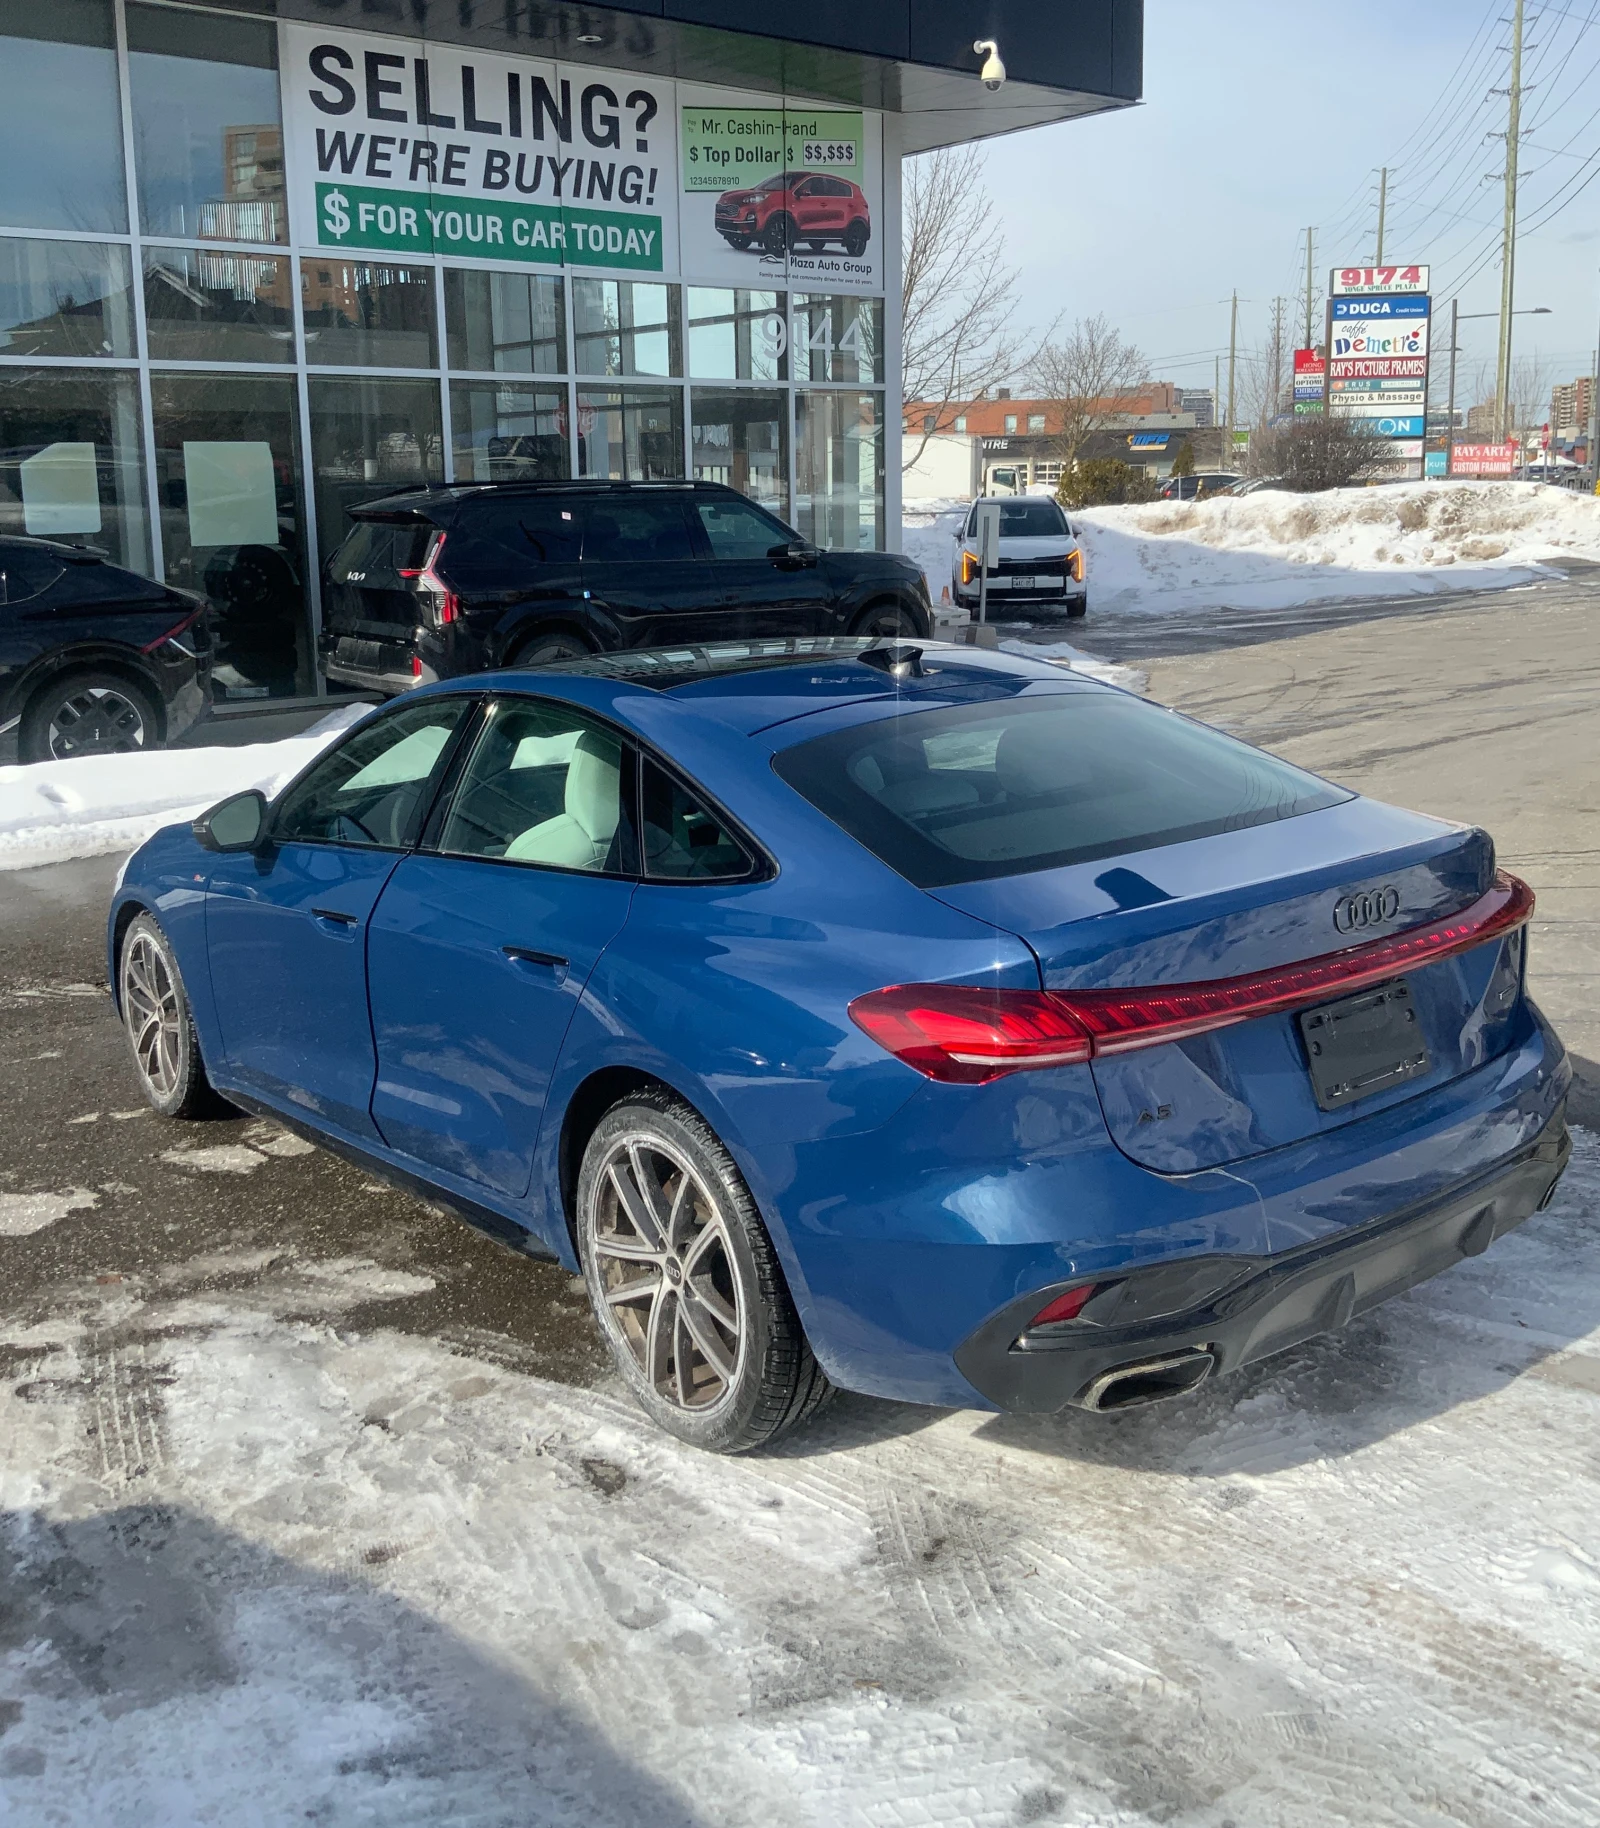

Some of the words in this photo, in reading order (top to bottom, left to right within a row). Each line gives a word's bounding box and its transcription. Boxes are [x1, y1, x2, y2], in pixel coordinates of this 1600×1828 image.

[309, 45, 658, 153] SELLING?
[702, 119, 723, 135] Mr.
[703, 146, 731, 167] Top
[735, 146, 781, 163] Dollar
[804, 144, 854, 164] $$,$$$
[315, 128, 471, 187] WE'RE
[483, 149, 658, 206] BUYING!
[689, 176, 740, 186] 12345678910
[323, 188, 350, 240] $
[358, 202, 419, 237] FOR
[424, 208, 504, 244] YOUR
[512, 218, 567, 249] CAR
[571, 222, 656, 257] TODAY
[790, 256, 815, 269] Plaza
[818, 259, 840, 271] Auto
[843, 261, 872, 275] Group
[799, 274, 823, 282] community
[823, 275, 837, 283] driven
[1341, 266, 1421, 287] 9174
[1344, 285, 1365, 293] YONGE
[1368, 284, 1392, 292] SPRUCE
[1349, 302, 1391, 315] DUCA
[1334, 334, 1420, 356] Demetre
[1330, 361, 1354, 377] RAY'S
[1354, 359, 1390, 376] PICTURE
[1390, 358, 1424, 376] FRAMES
[1332, 394, 1365, 403] Physio
[1367, 393, 1375, 401] &
[1377, 392, 1422, 402] Massage
[1481, 446, 1506, 457] ART
[1452, 461, 1480, 473] CUSTOM
[1481, 461, 1511, 473] FRAMING
[1136, 1103, 1173, 1127] A5
